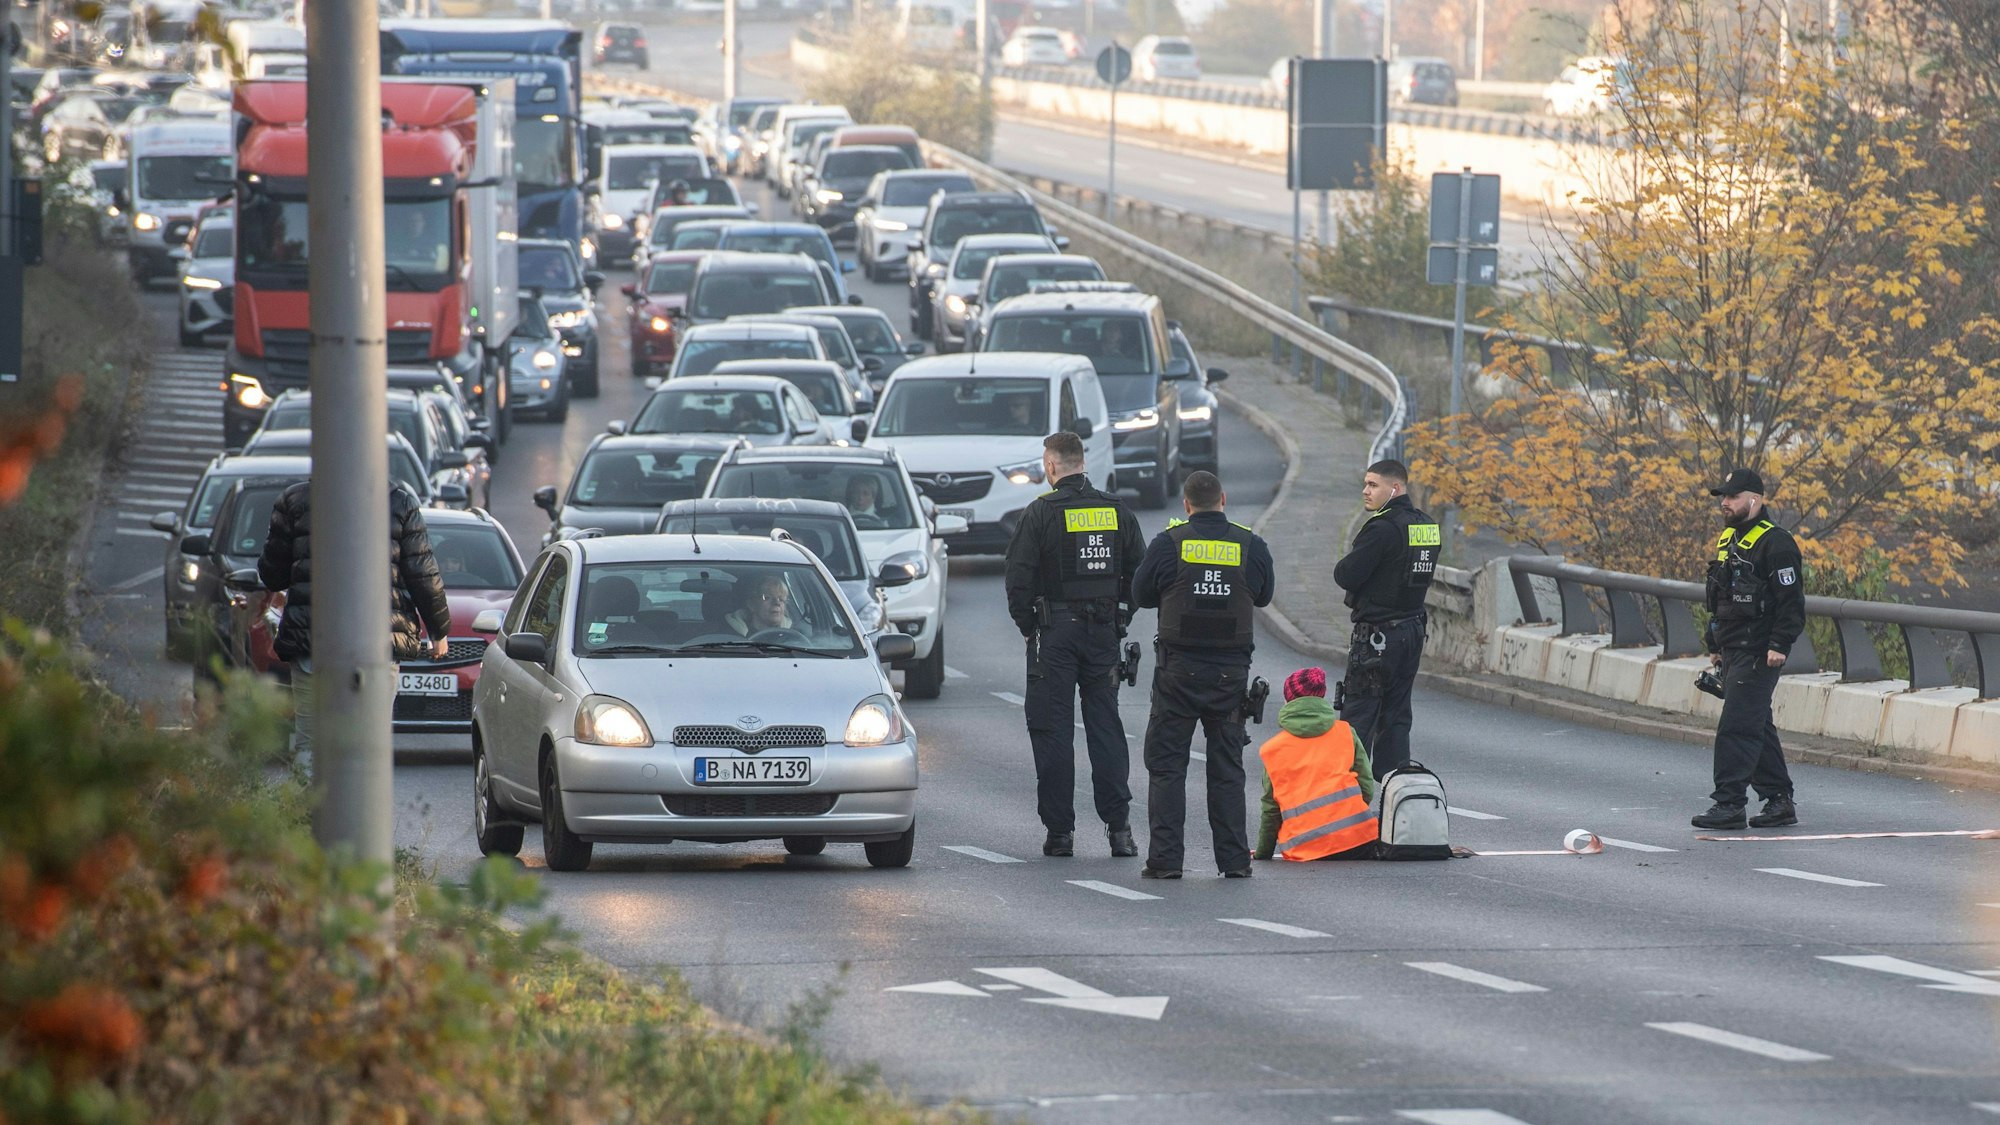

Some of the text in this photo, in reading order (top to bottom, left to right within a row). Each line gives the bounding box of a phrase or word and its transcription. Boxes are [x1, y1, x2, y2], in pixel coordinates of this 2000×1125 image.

[1069, 511, 1116, 528] POLIZEI
[1088, 534, 1103, 546] BE
[1410, 526, 1440, 543] POLIZEI
[1080, 547, 1111, 558] 15101
[1185, 543, 1238, 562] POLIZEI
[1420, 550, 1430, 561] BE
[1412, 562, 1433, 572] 15111
[1204, 570, 1222, 582] BE
[1193, 582, 1231, 595] 15115
[414, 676, 451, 690] 3480
[707, 761, 719, 779] B
[733, 761, 757, 779] NA
[761, 761, 808, 779] 7139
